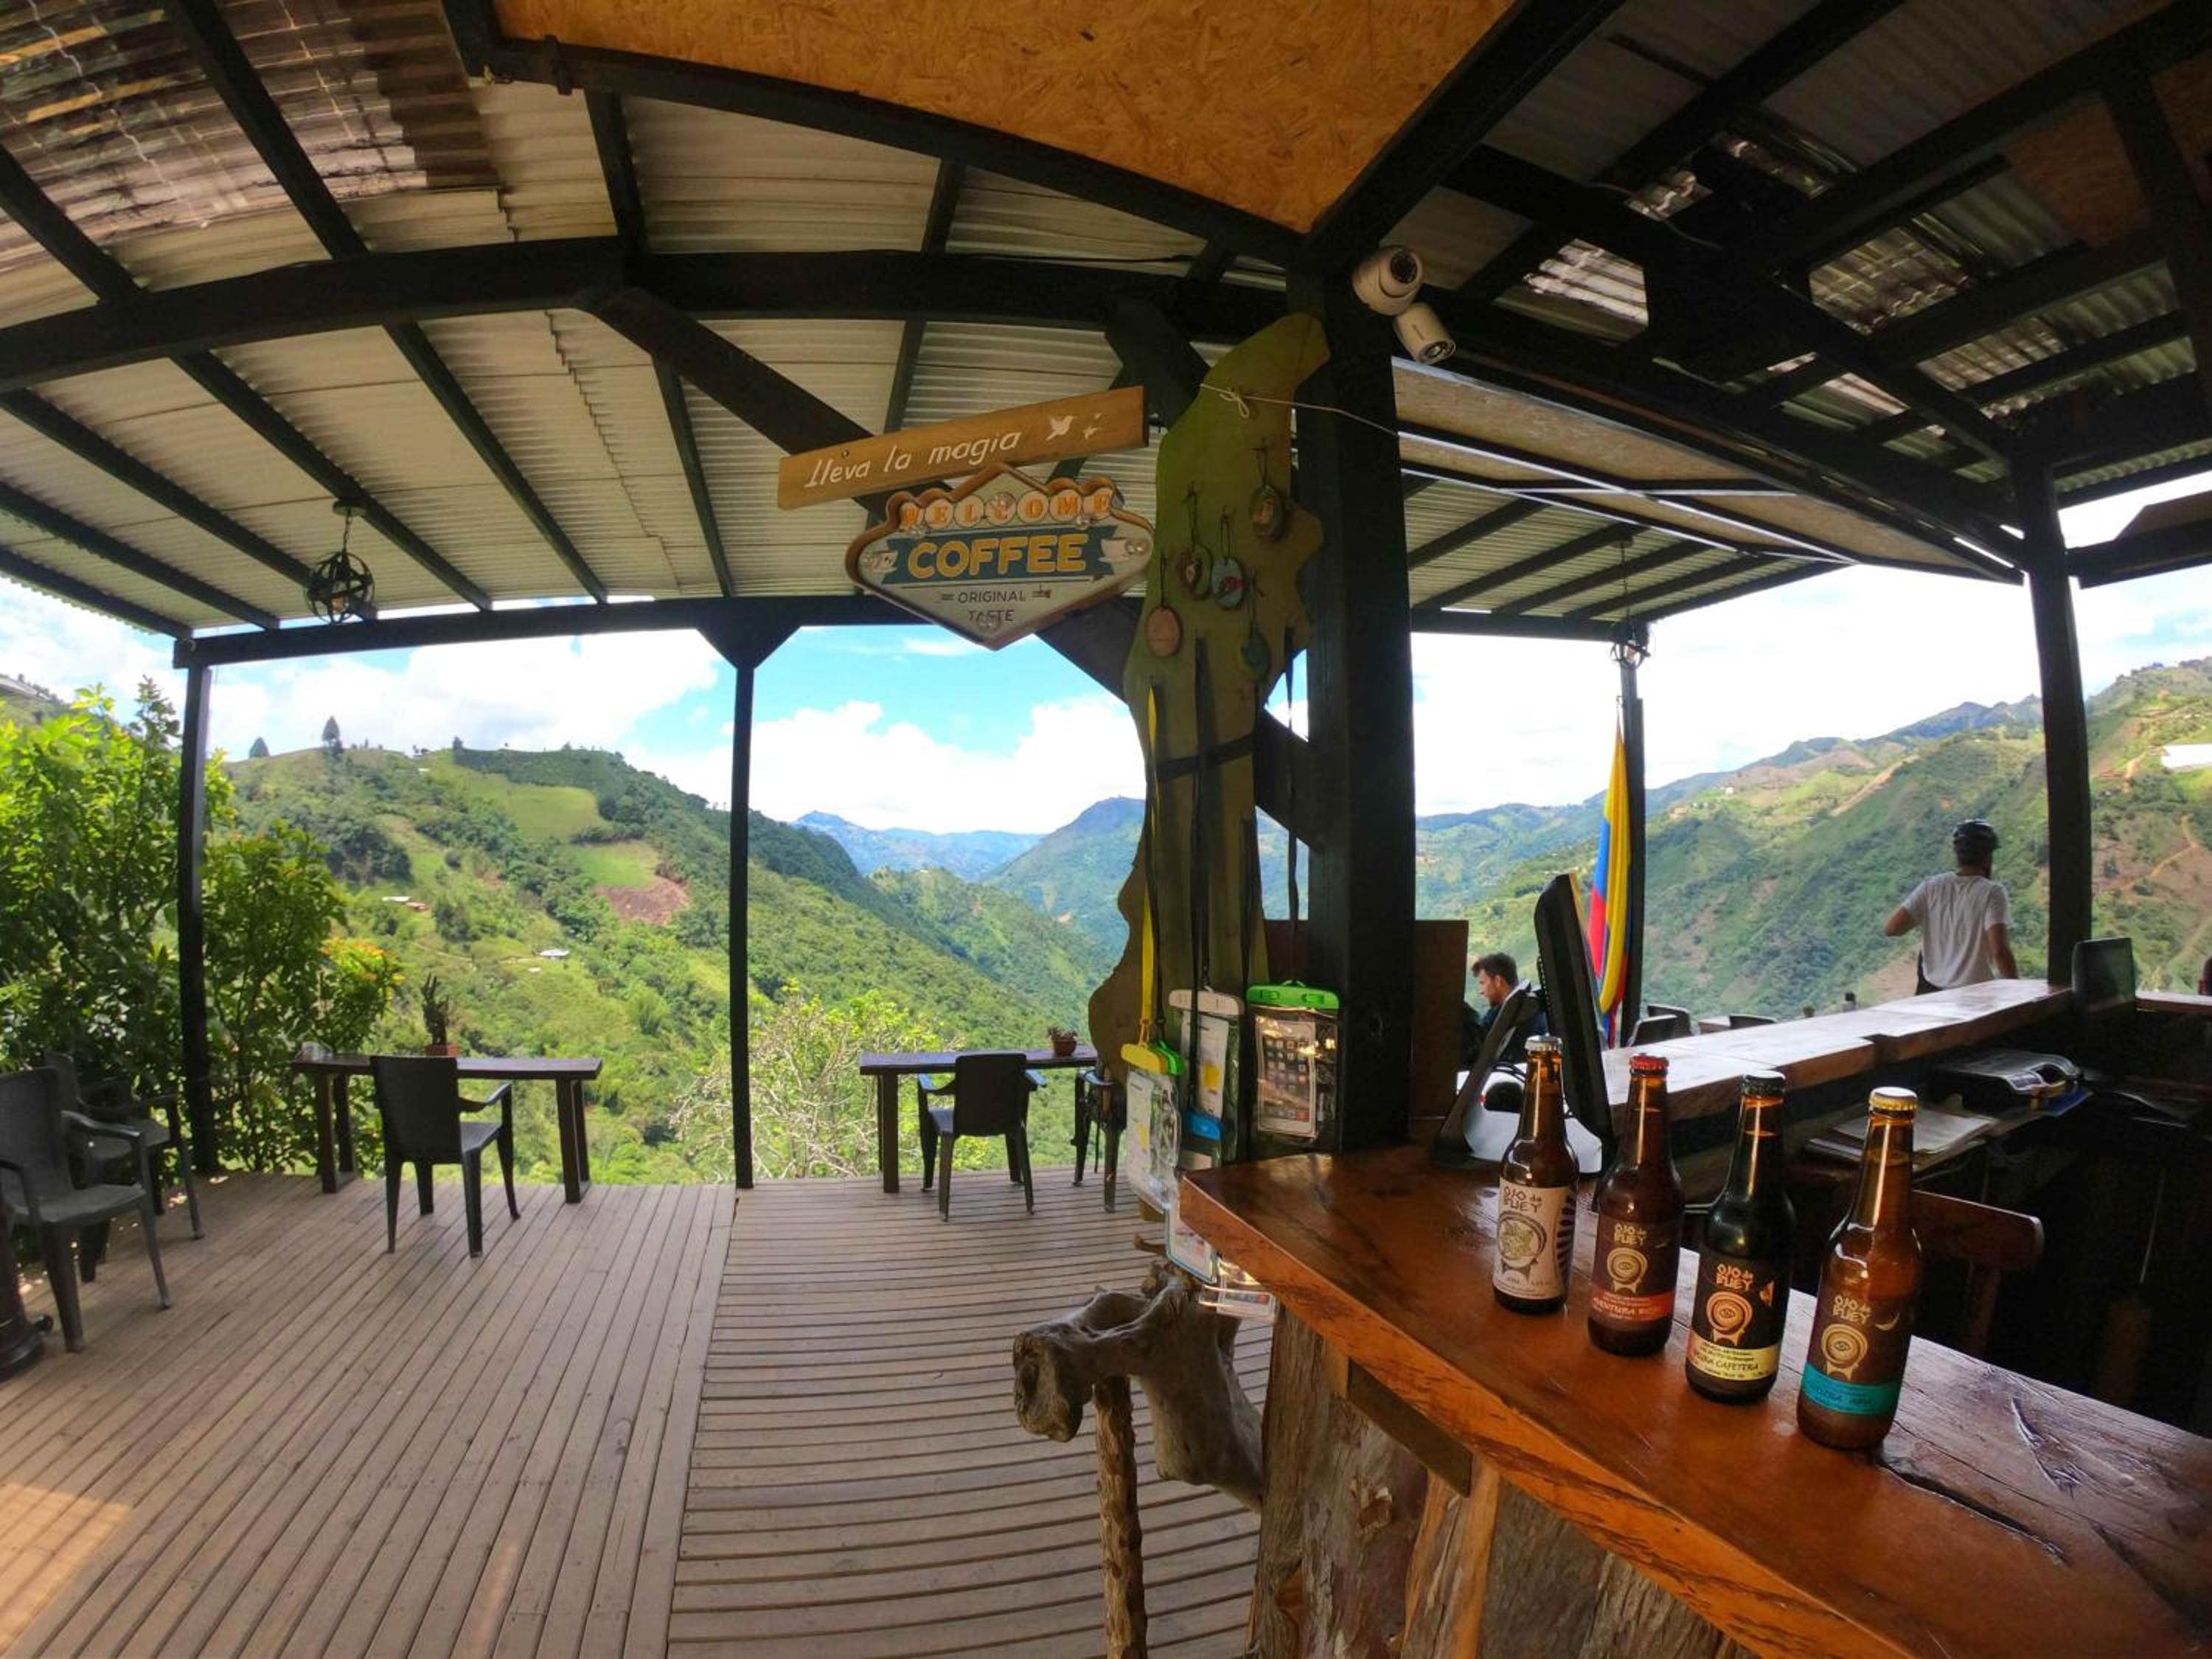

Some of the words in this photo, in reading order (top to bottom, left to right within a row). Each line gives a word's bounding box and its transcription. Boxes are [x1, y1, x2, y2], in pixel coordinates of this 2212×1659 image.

[884, 445, 911, 473] la
[928, 431, 1022, 466] magia
[908, 534, 1090, 578] COFFEE
[959, 591, 1027, 603] ORIGINAL
[967, 609, 1015, 625] TASTE
[1503, 1186, 1526, 1200] OJO
[1503, 1197, 1543, 1213] BUEY
[1717, 1263, 1742, 1279] OJO
[1834, 1294, 1858, 1310] OJO
